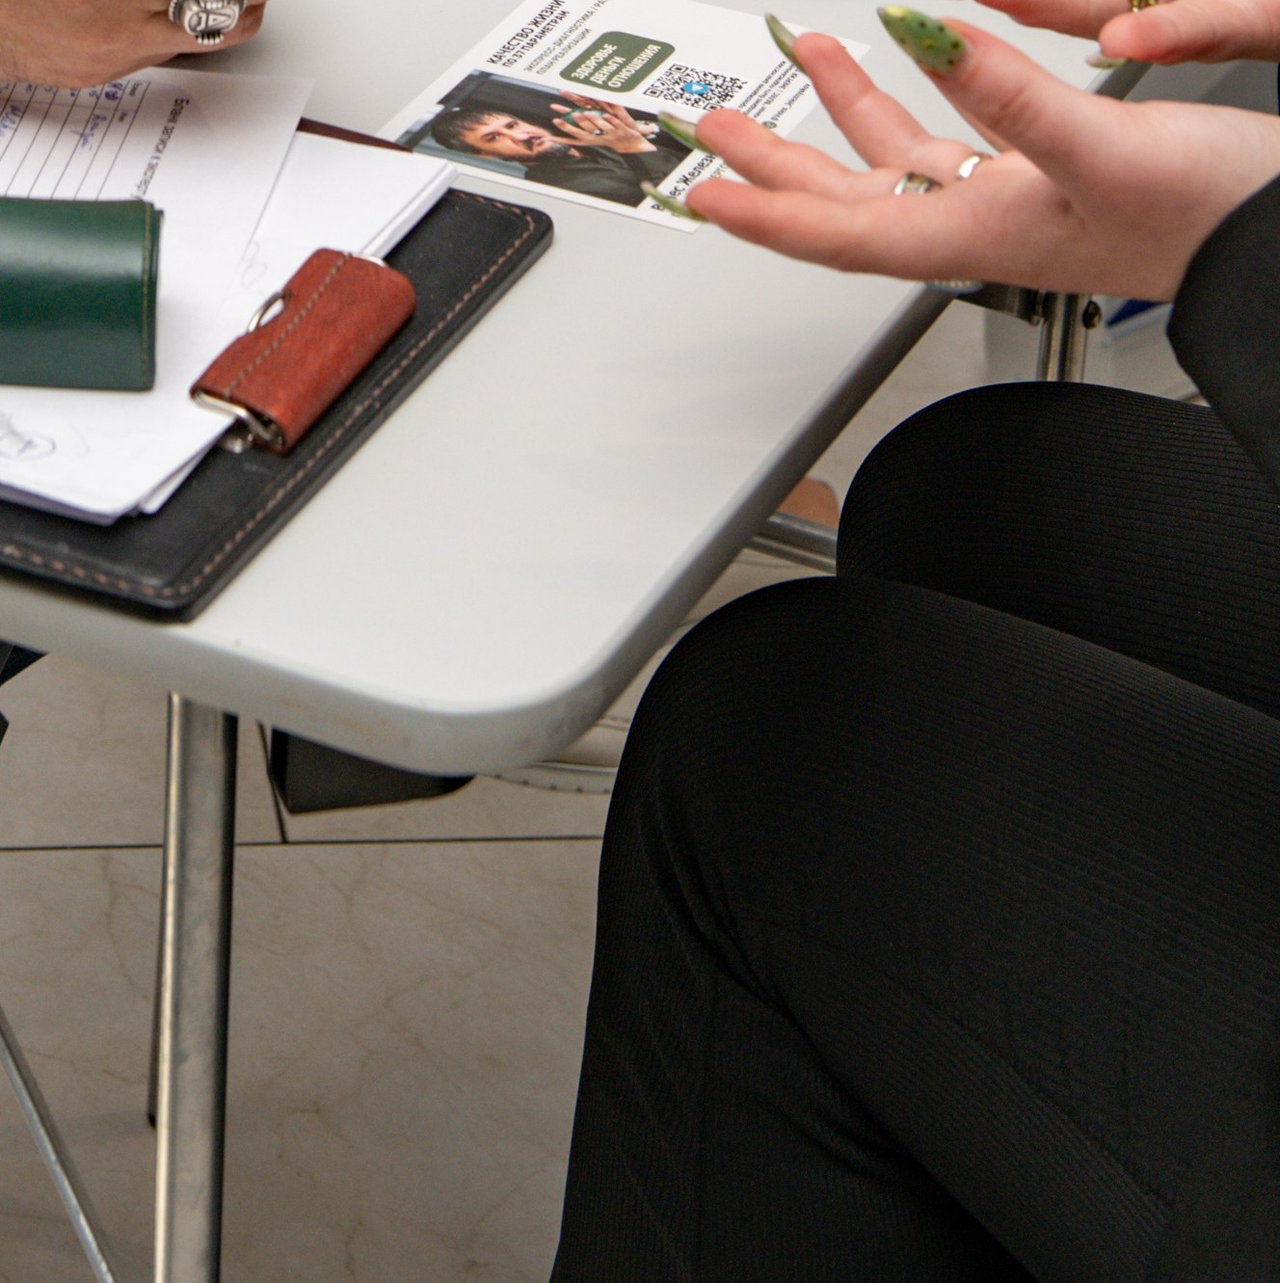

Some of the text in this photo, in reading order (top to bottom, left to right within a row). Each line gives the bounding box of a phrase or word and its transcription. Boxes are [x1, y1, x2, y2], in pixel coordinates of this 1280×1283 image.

[486, 0, 565, 65] КАЧЕСТВО ЖИЗНИ
[502, 10, 570, 68] ПО 37 ПАРАМЕТРАМ
[536, 28, 592, 75] ПЛАН РЕАЛИЗАЦИИ
[571, 43, 617, 80] ЗДОРОВЬЕ
[590, 56, 626, 85] ДЕНЬГИ
[608, 44, 661, 88] ОТНОШЕНИЯ
